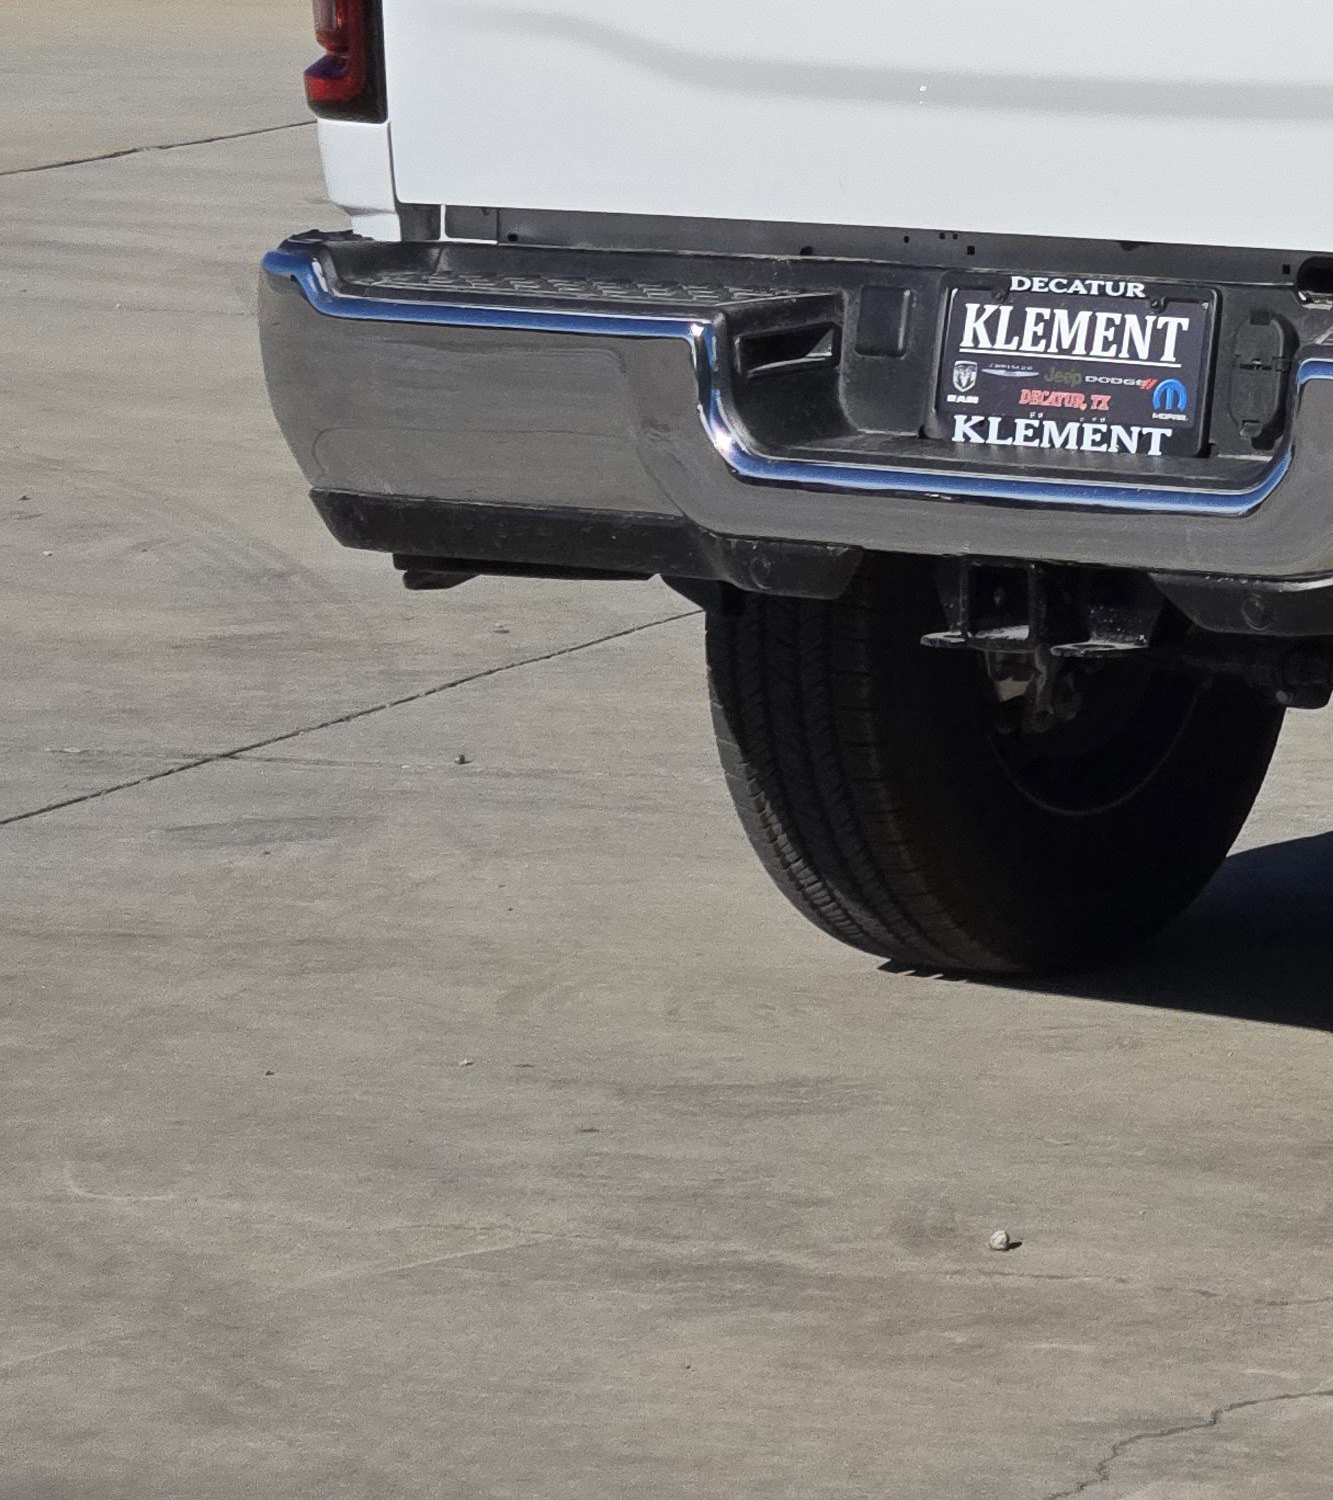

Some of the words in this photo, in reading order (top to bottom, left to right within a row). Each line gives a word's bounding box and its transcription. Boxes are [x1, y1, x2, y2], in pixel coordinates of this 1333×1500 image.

[1010, 275, 1146, 298] DECATUR
[959, 303, 1189, 362] KLEMENT
[1043, 366, 1082, 387] Jeep
[1018, 388, 1087, 411] DECATUR,
[1090, 394, 1112, 411] TX
[952, 414, 1172, 456] KLEMENT
